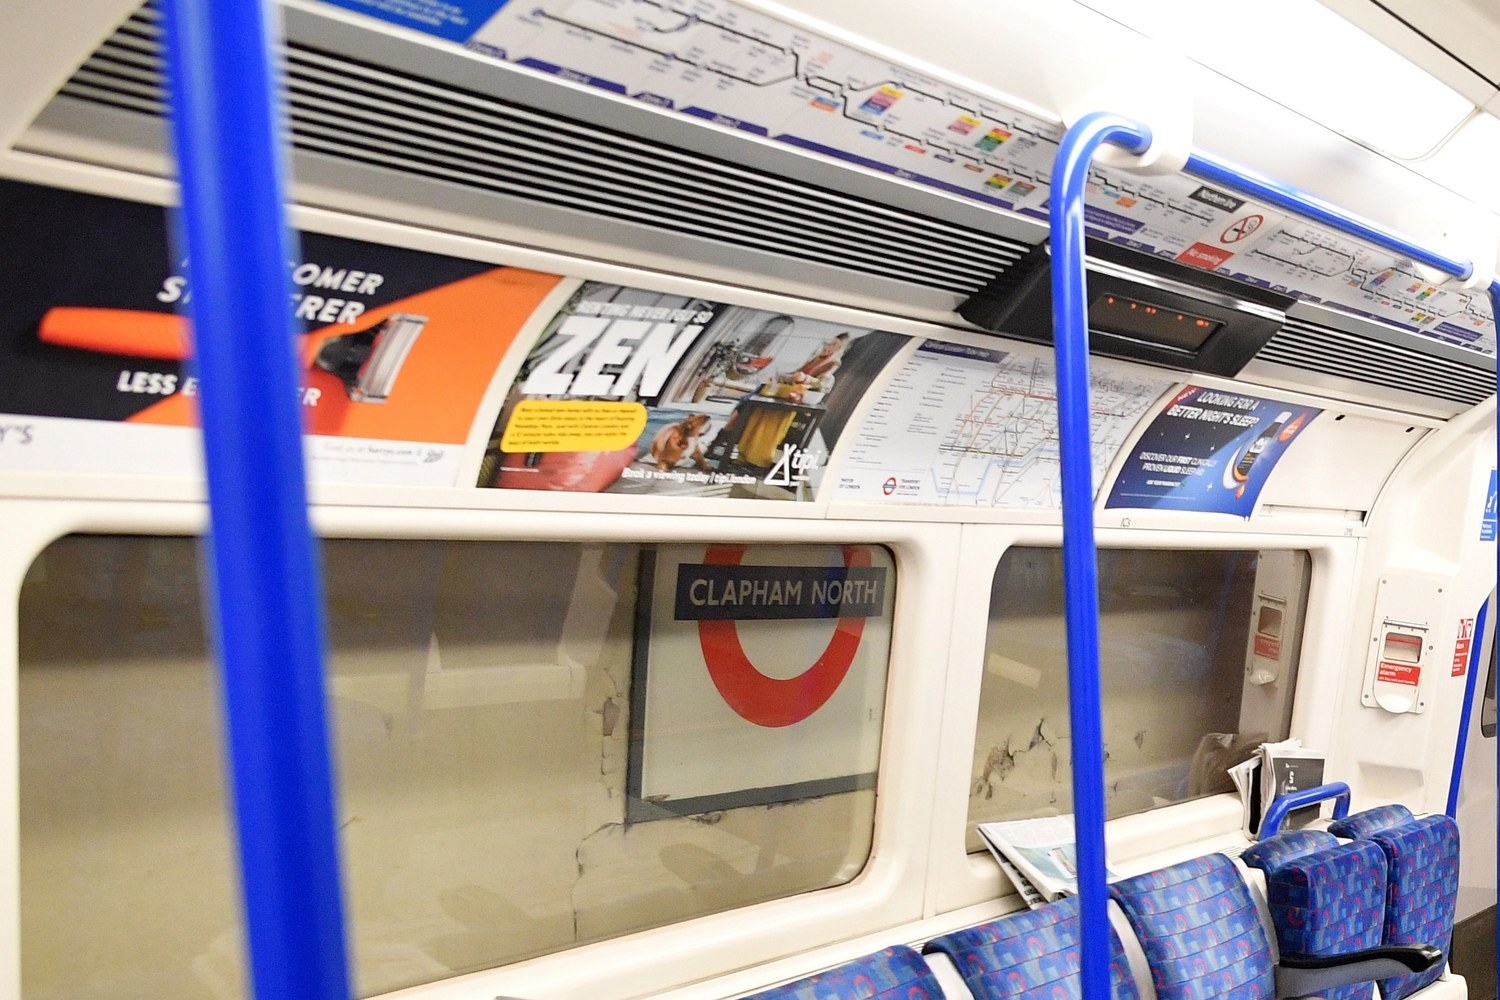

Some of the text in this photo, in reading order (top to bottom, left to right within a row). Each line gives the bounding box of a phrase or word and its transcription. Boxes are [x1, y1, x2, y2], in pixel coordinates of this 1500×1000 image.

[520, 315, 705, 397] ZEN
[116, 369, 179, 395] LESS
[1197, 391, 1261, 411] LOOKING FOR A
[1166, 404, 1260, 428] BETTER NIGHT'S SLEEP?
[688, 579, 878, 606] CLAPHAM NORTH
[1379, 669, 1397, 677] alarm
[1380, 662, 1413, 674] Emergency
